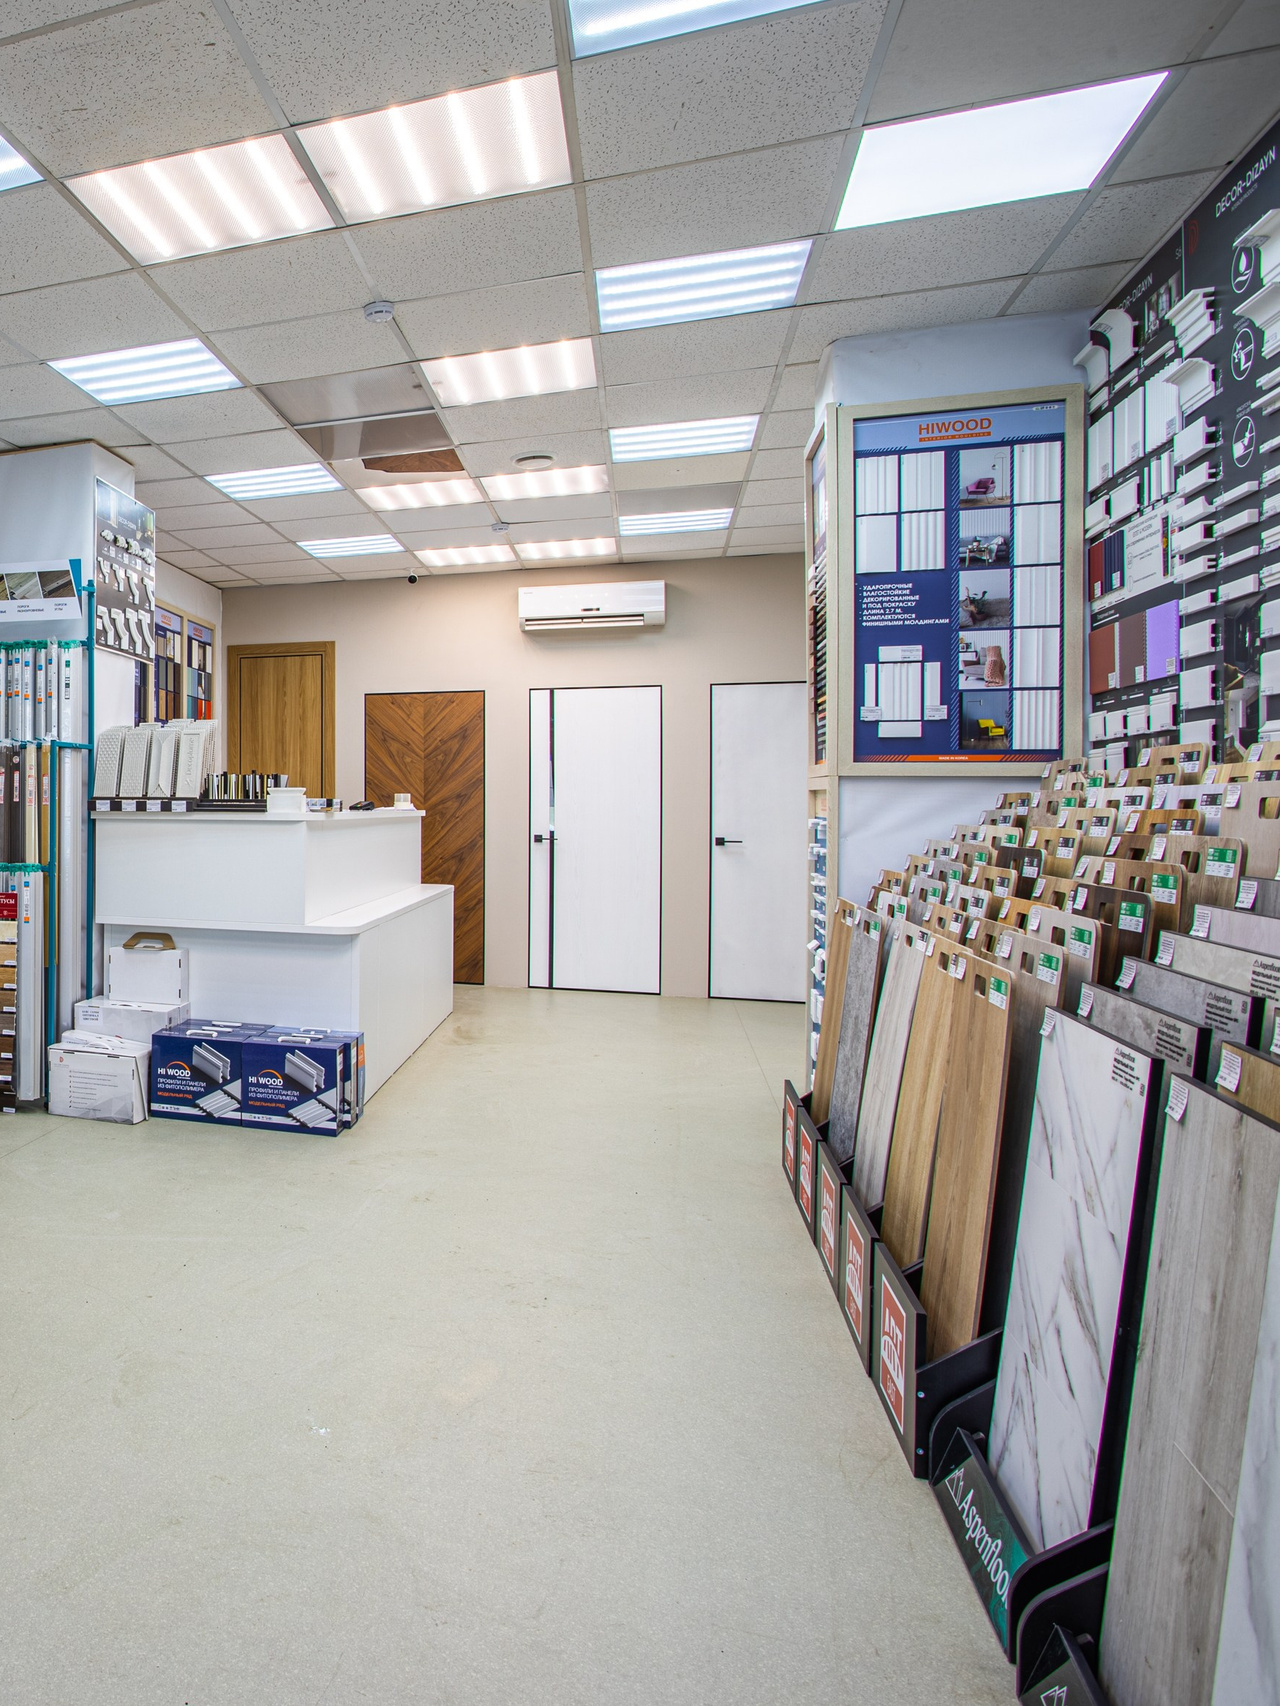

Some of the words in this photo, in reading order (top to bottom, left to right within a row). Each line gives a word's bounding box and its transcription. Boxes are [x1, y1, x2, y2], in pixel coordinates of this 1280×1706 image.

[1215, 145, 1276, 218] DECOR-DIZAYN
[919, 417, 993, 435] HIWOOD
[862, 595, 920, 603] ДЕКОРИРОВАННЫЕ
[157, 1067, 166, 1075] HI
[166, 1068, 191, 1077] WOOD
[258, 1077, 283, 1086] WOOD
[165, 1084, 205, 1092] ФИТОПОЛИМЕРА
[256, 1093, 298, 1101] ФИТОПОЛИМЕРА
